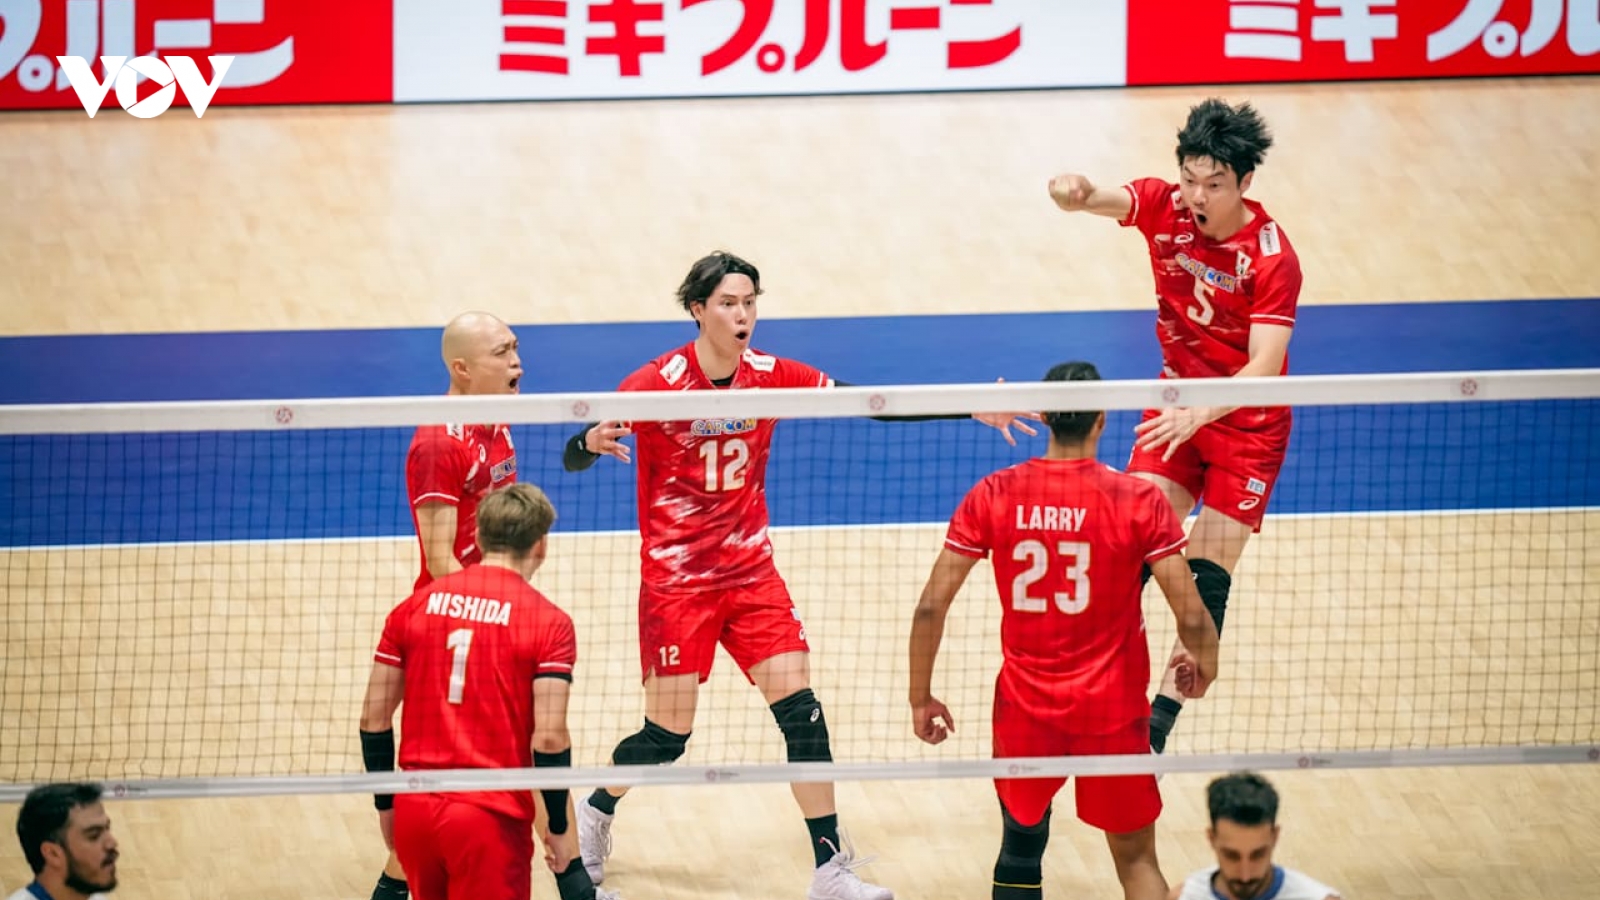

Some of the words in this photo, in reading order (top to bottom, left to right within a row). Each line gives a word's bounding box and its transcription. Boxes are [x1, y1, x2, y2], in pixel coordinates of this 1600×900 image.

[498, 0, 1021, 76] ミキプルーン
[1187, 276, 1214, 325] 5
[691, 419, 757, 435] CAPCOM
[699, 438, 749, 491] 12
[1016, 505, 1087, 532] LARRY
[1012, 540, 1091, 615] 23
[425, 592, 512, 627] NISHIDA
[446, 628, 473, 705] 1
[659, 645, 681, 667] 12
